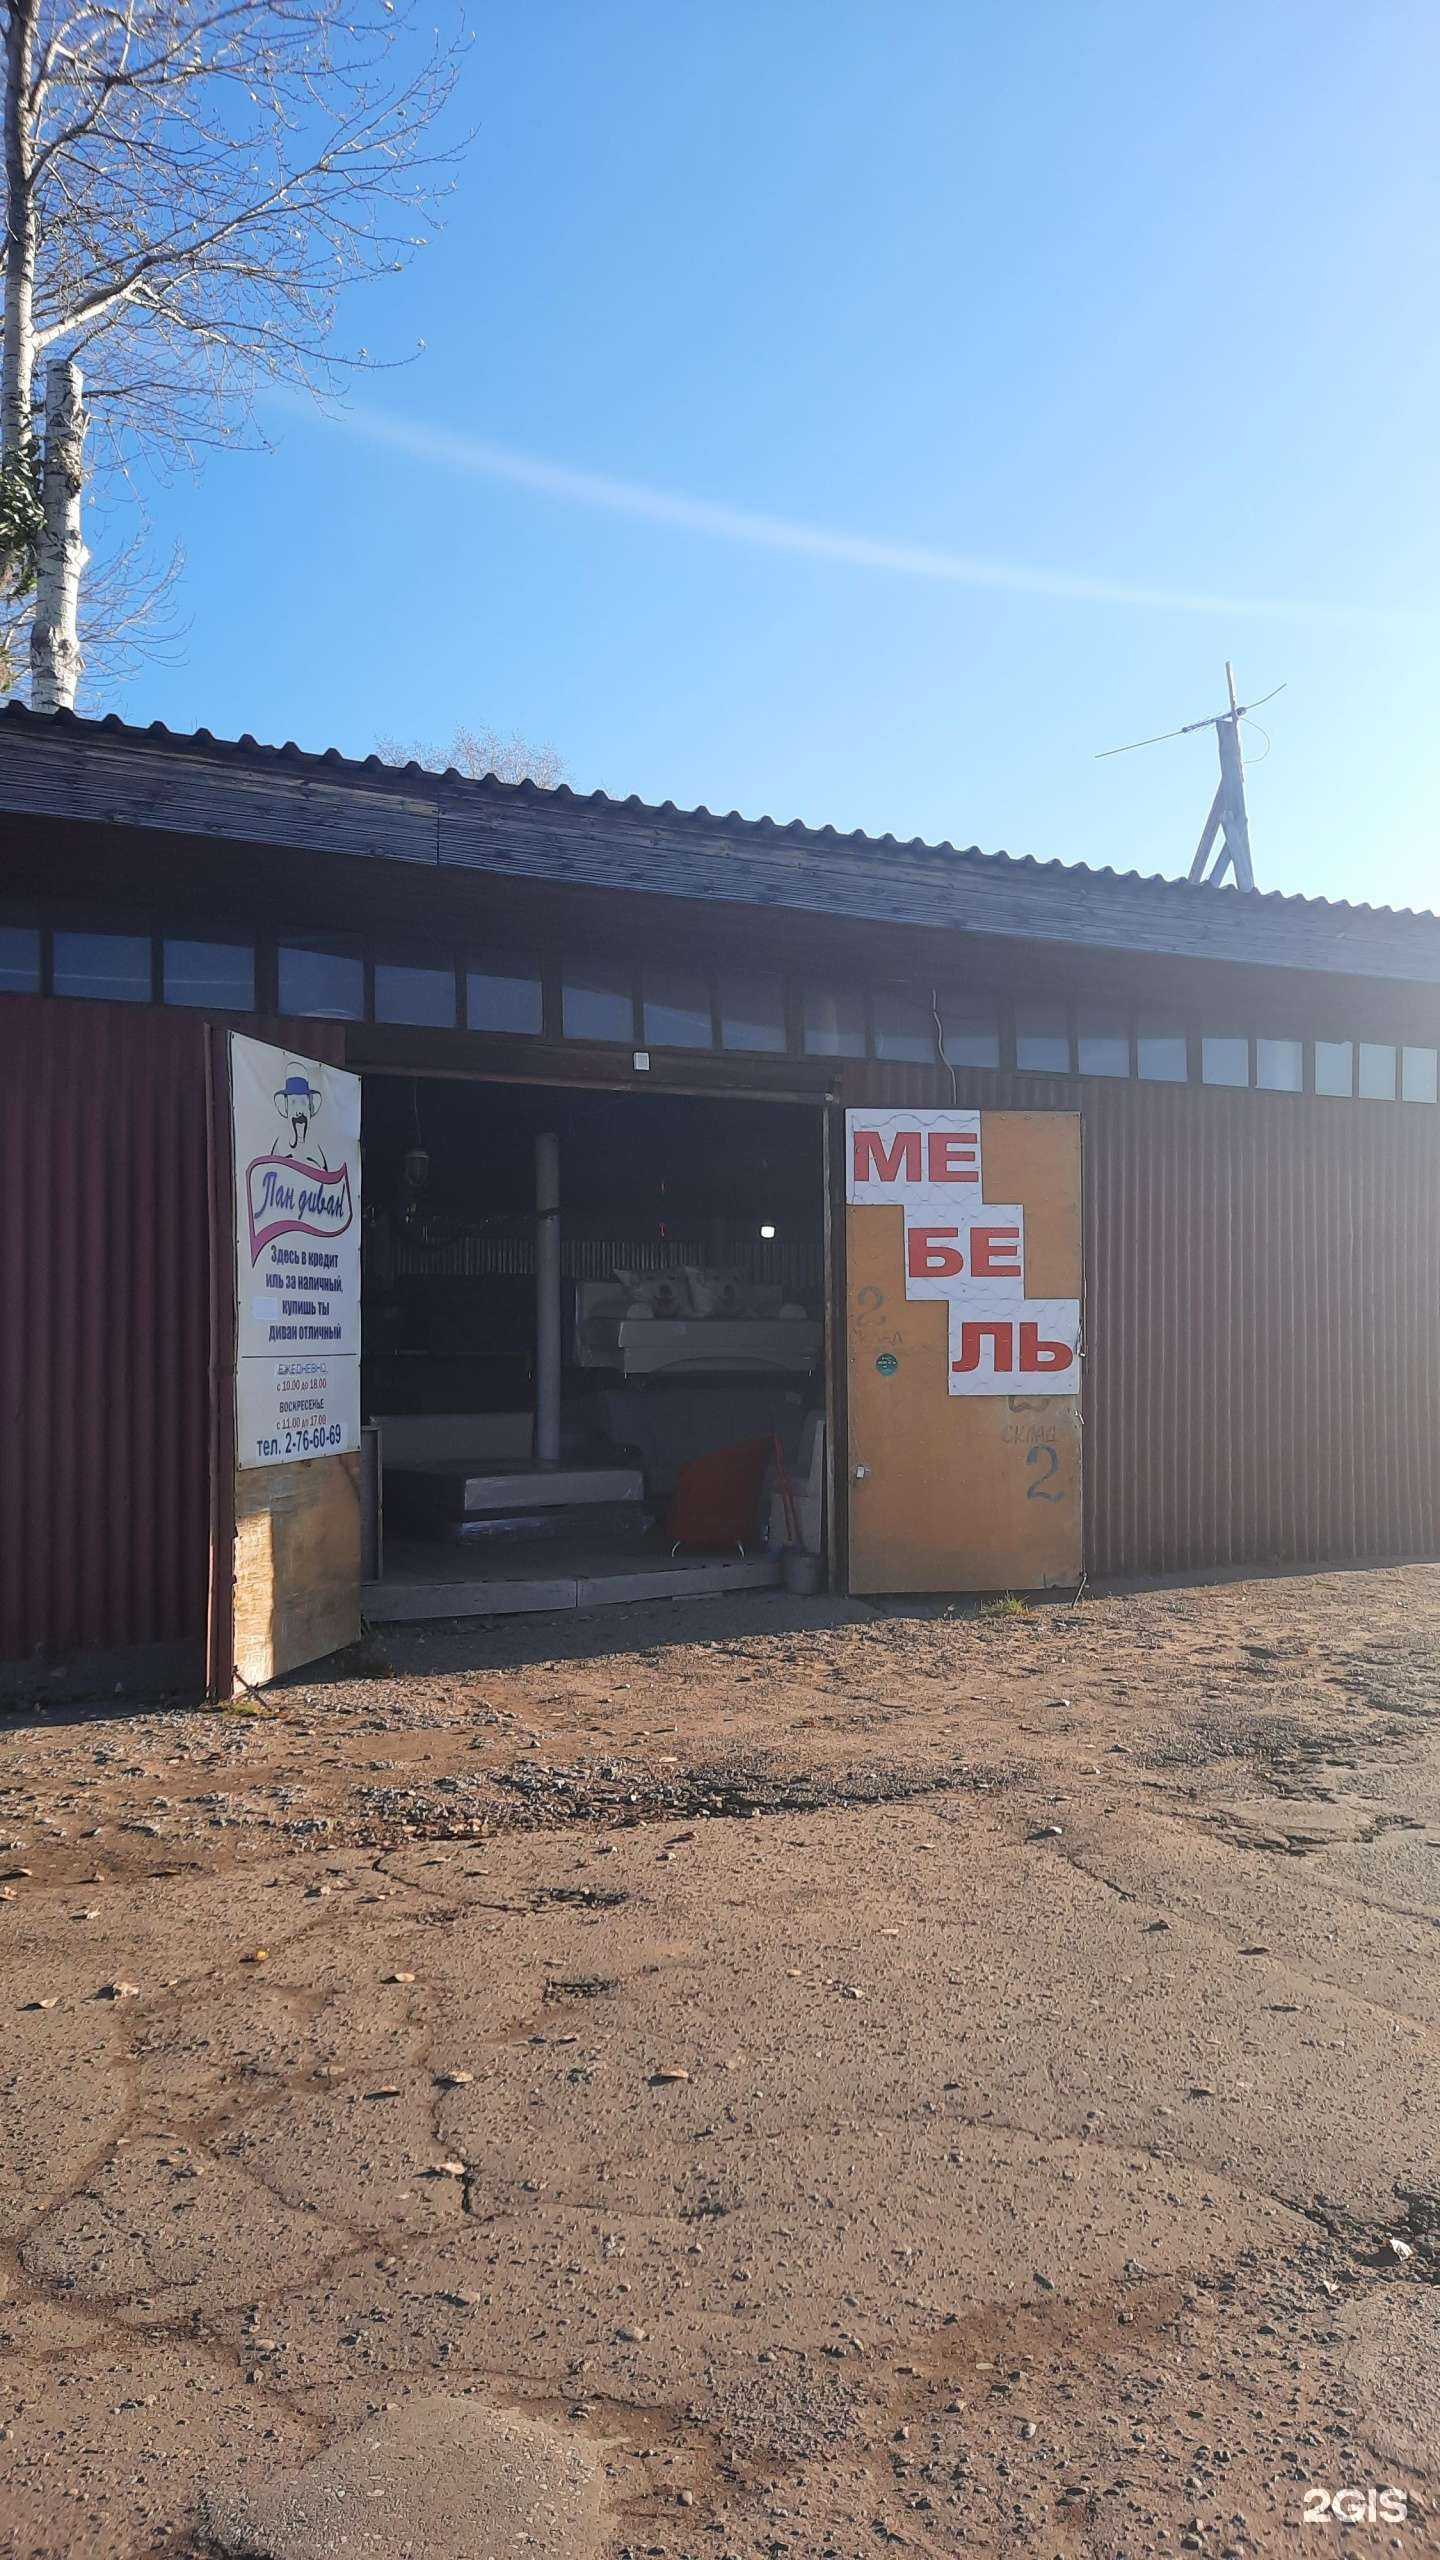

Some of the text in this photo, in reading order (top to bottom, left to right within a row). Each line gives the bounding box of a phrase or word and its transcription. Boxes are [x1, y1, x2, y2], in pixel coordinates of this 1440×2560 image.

[853, 1131, 979, 1183] МЕ
[255, 1171, 345, 1220] Пан диван
[270, 1244, 339, 1270] Здесь в кредит
[907, 1227, 1021, 1278] БЕ
[265, 1273, 344, 1293] иль за наличный,
[282, 1300, 330, 1316] купишь ты
[268, 1322, 342, 1343] диван отличный
[951, 1322, 1074, 1373] ЛЬ
[279, 1398, 325, 1413] ВОСКРЕСЕНЬЕ
[257, 1423, 342, 1456] тел. 2-76-60-69
[1025, 1443, 1066, 1503] 2
